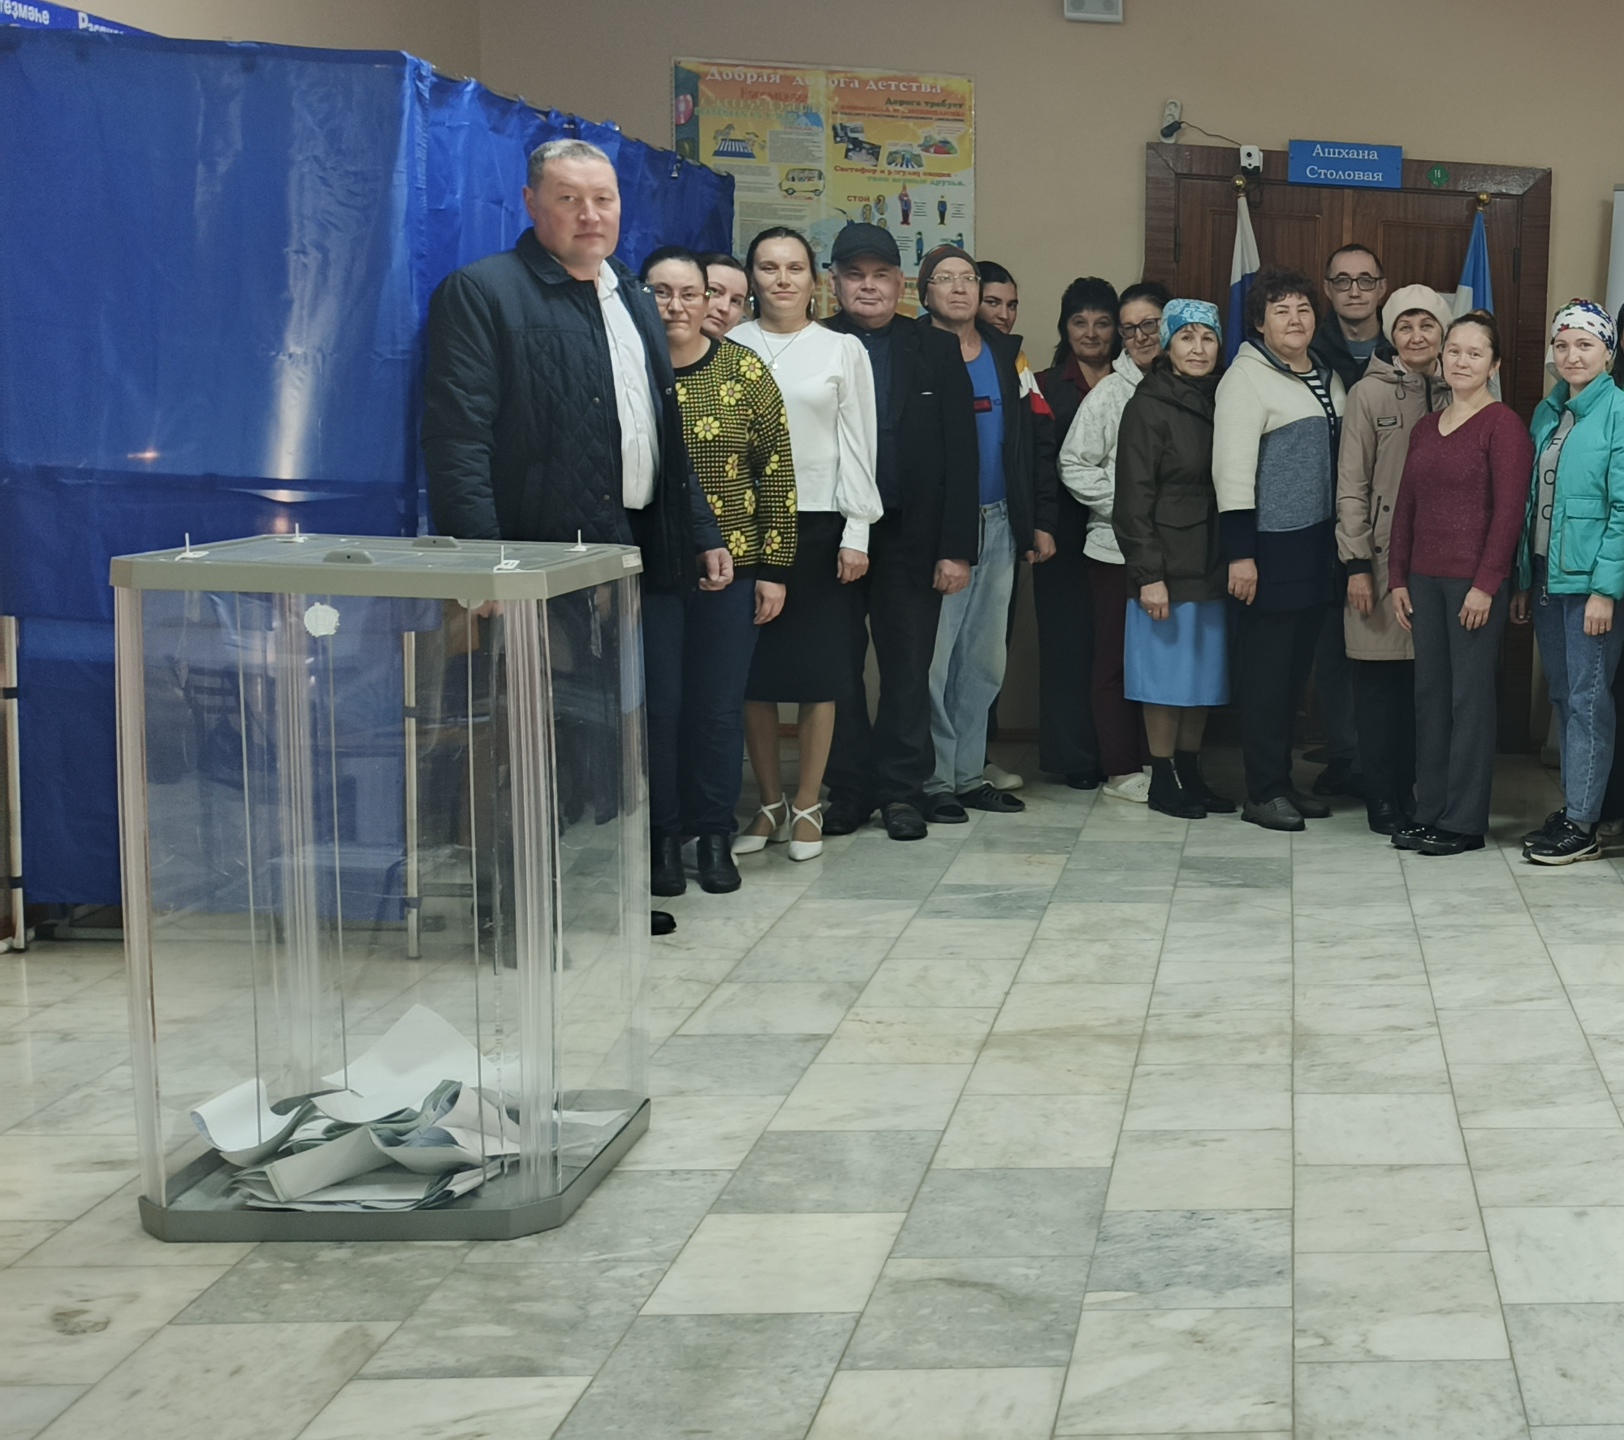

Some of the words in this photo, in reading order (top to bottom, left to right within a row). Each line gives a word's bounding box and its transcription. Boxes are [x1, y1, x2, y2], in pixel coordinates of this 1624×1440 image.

[706, 66, 780, 85] Добрая
[792, 75, 860, 89] доога
[865, 79, 942, 94] детства
[1312, 144, 1379, 160] Ашхана
[1306, 165, 1383, 181] Столовая
